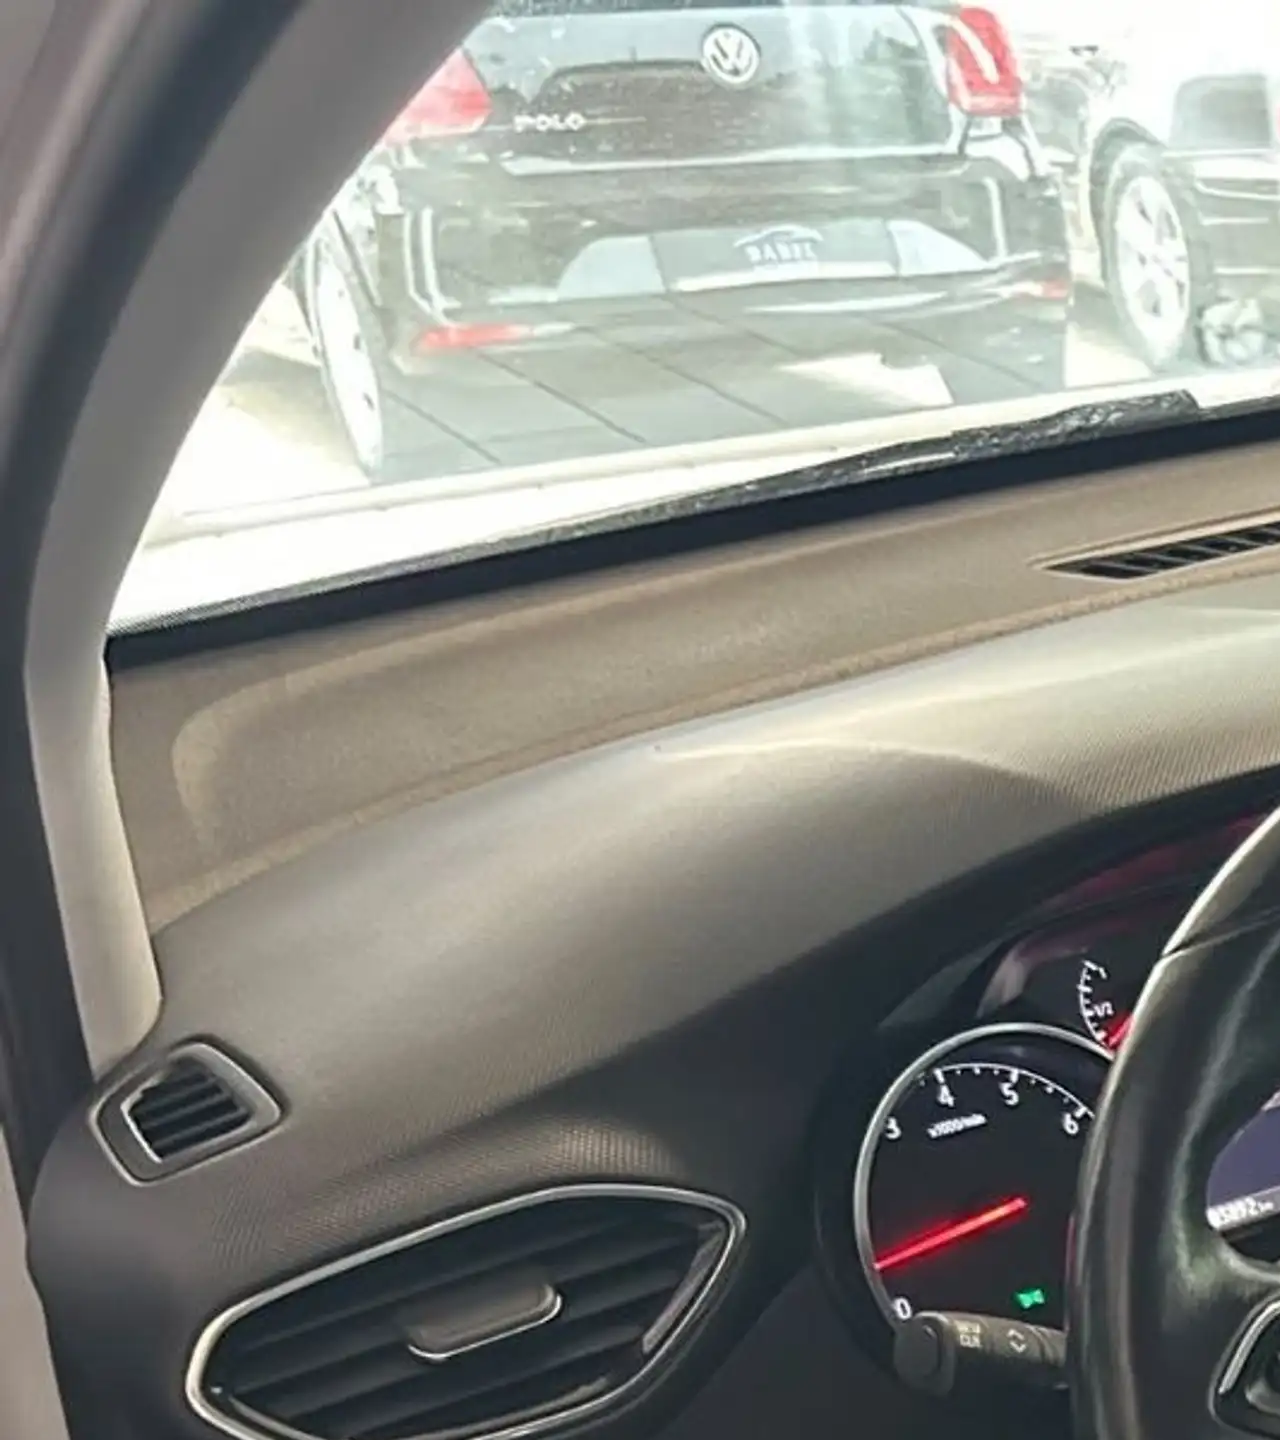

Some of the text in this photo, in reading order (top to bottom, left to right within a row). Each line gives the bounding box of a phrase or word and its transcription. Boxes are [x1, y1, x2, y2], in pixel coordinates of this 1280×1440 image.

[513, 112, 585, 133] POLO
[938, 1084, 955, 1107] 4
[1000, 1082, 1019, 1106] 5
[885, 1117, 902, 1140] 3
[1062, 1111, 1080, 1135] 6
[894, 1296, 912, 1320] 0
